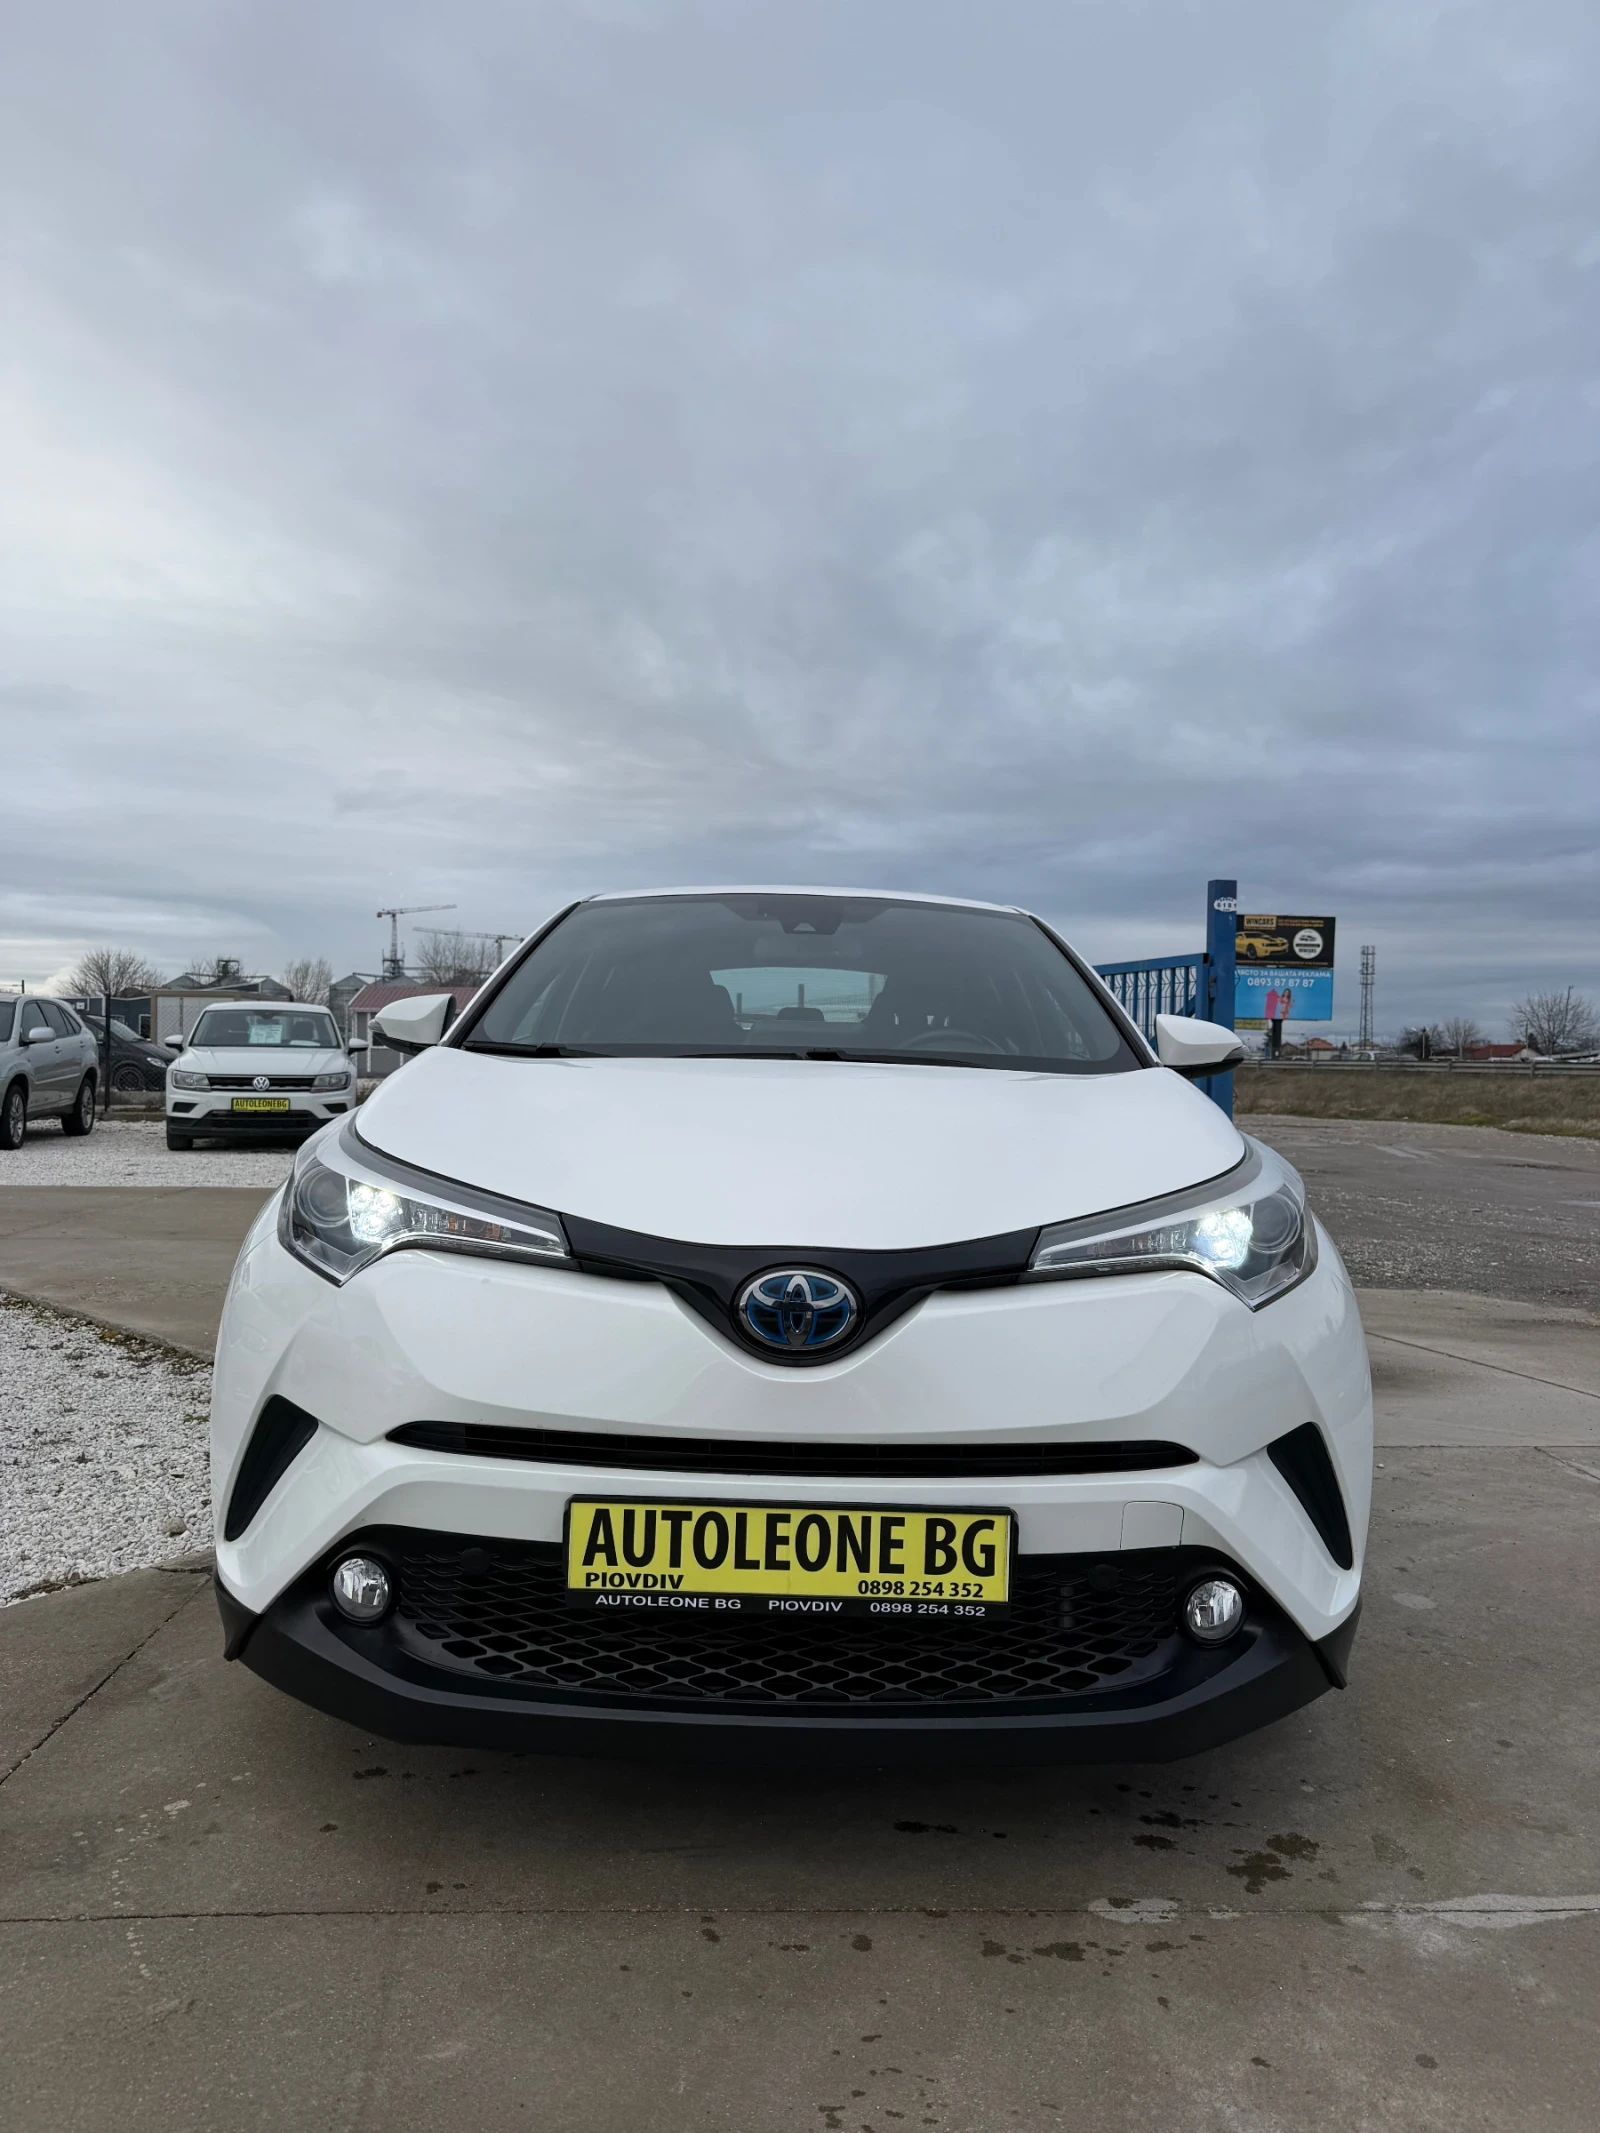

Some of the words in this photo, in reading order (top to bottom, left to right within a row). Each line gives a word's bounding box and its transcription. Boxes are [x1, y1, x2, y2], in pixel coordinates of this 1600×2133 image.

[1246, 918, 1274, 926] WINCARS
[1247, 978, 1271, 987] 0893
[1274, 978, 1285, 987] 87
[1288, 979, 1300, 987] 87
[1302, 979, 1315, 988] 87
[582, 1508, 906, 1574] AUTOLEONE
[923, 1517, 996, 1577] BG
[585, 1572, 684, 1589] PIOVDIV
[857, 1579, 905, 1595] 0898
[909, 1581, 945, 1597] 254
[949, 1582, 984, 1598] 352
[595, 1594, 710, 1609] AUTOLEONE
[715, 1599, 741, 1610] BG
[768, 1600, 843, 1612] PIOVDIV
[869, 1602, 913, 1613] 0898
[917, 1604, 949, 1615] 254
[954, 1605, 986, 1616] 352
